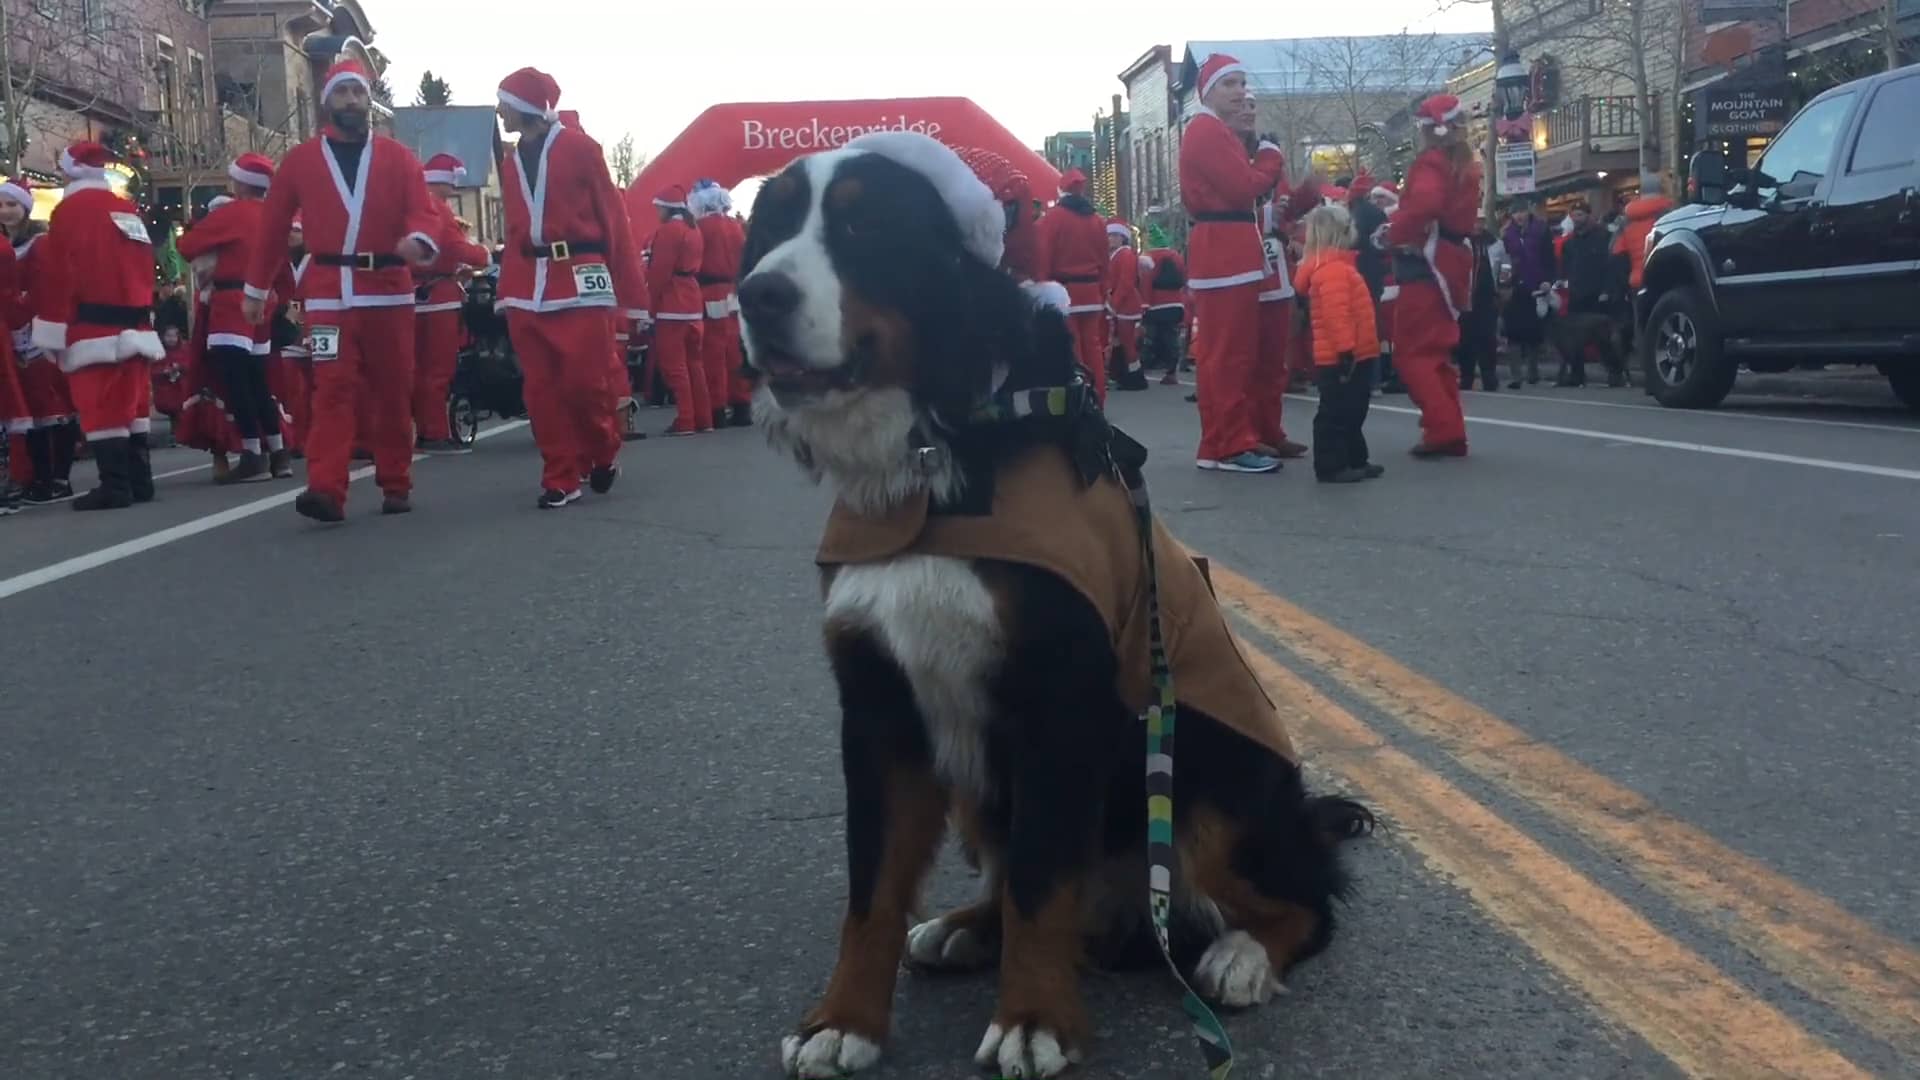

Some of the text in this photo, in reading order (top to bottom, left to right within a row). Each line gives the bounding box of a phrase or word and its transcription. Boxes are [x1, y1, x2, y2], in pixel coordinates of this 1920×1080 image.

[1739, 92, 1756, 100] THE
[1711, 99, 1783, 111] MOUNTAIN
[1729, 110, 1766, 120] GOAT
[1711, 121, 1768, 134] CLOTHIN
